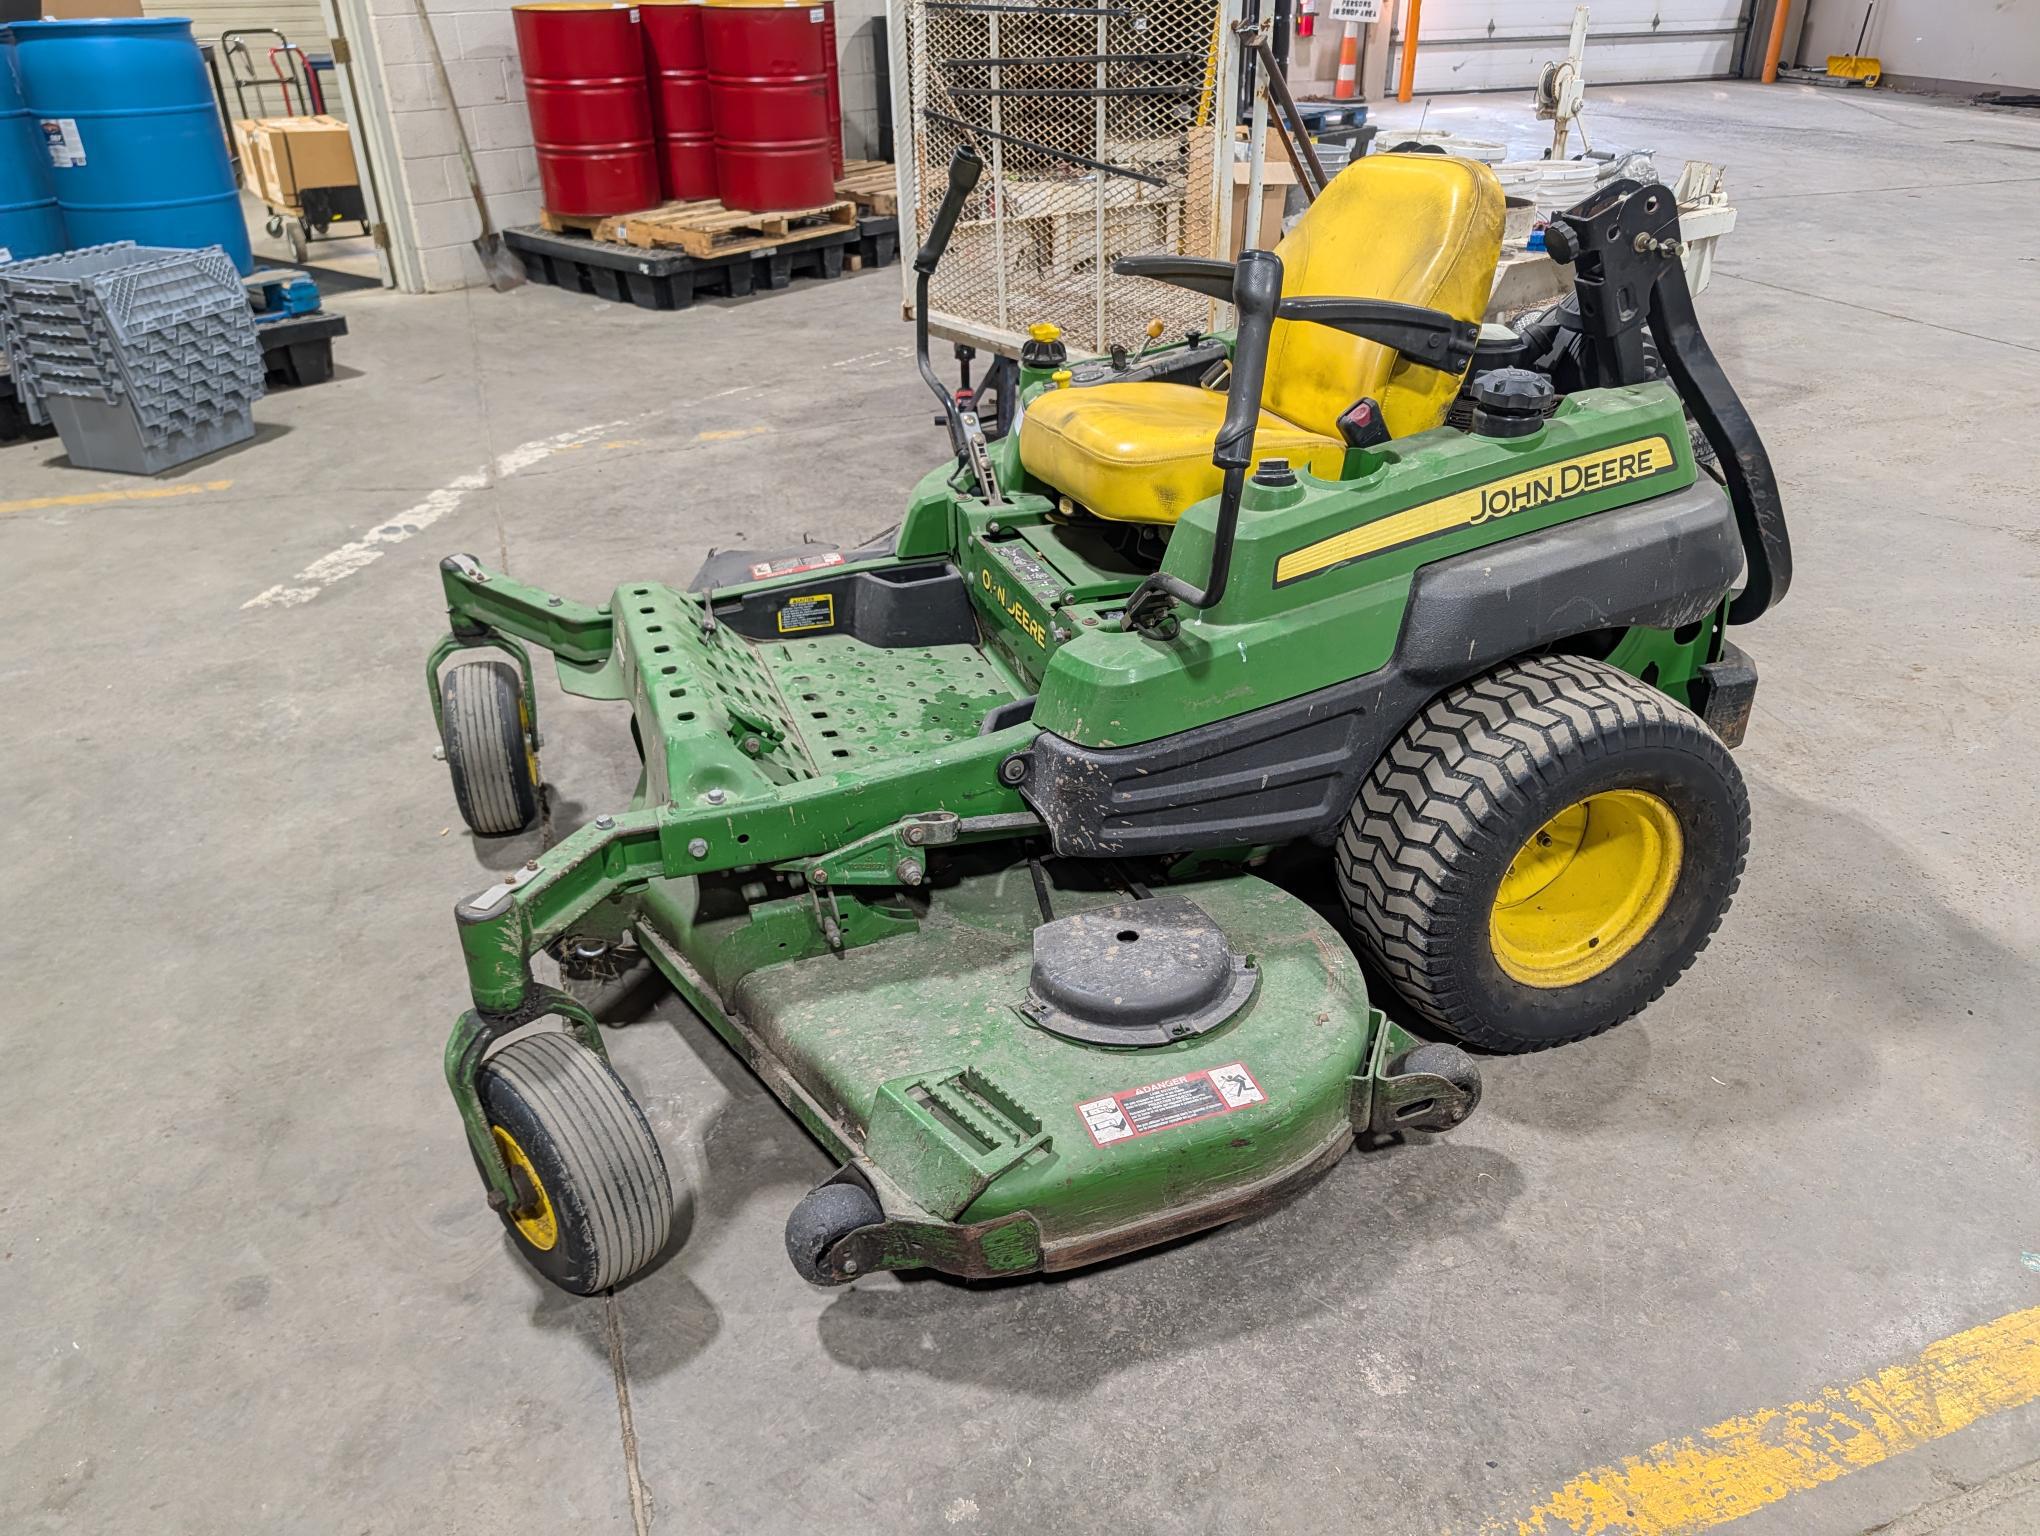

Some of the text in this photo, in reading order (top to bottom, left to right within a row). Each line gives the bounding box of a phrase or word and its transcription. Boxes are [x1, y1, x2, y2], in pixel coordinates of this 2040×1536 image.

[1341, 8, 1359, 16] SHOP
[1360, 9, 1377, 17] AREA
[1470, 448, 1654, 523] JOHN DEERE
[1143, 1076, 1188, 1094] DANGER
